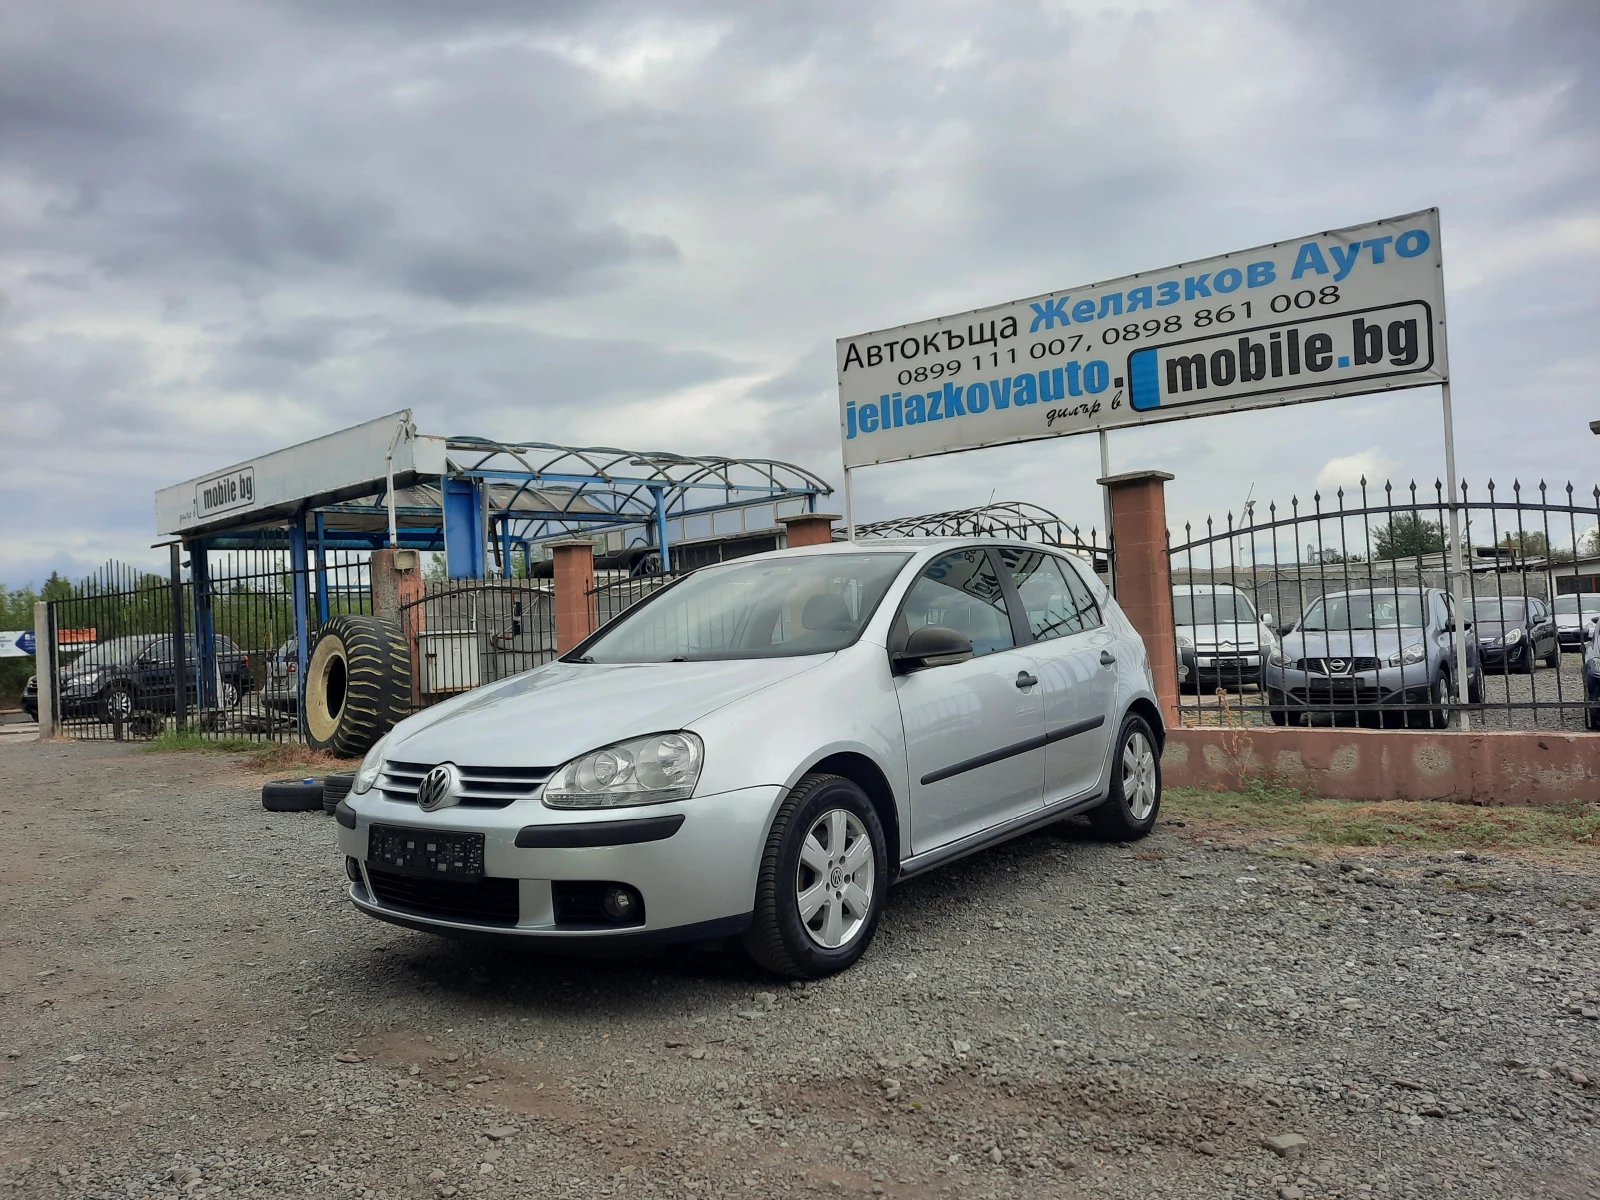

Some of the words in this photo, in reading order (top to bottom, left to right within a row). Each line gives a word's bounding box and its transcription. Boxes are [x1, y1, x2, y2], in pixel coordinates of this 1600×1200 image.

[842, 315, 1018, 372] Автокъща
[1028, 260, 1277, 333] Желязков
[1290, 229, 1431, 283] Ауто
[897, 359, 961, 386] 0899
[972, 347, 1016, 371] 111
[1029, 334, 1092, 360] 007,
[1101, 315, 1182, 345] 0898
[1193, 301, 1252, 328] 861
[1270, 285, 1341, 314] 008
[1165, 318, 1419, 395] mobile.bg
